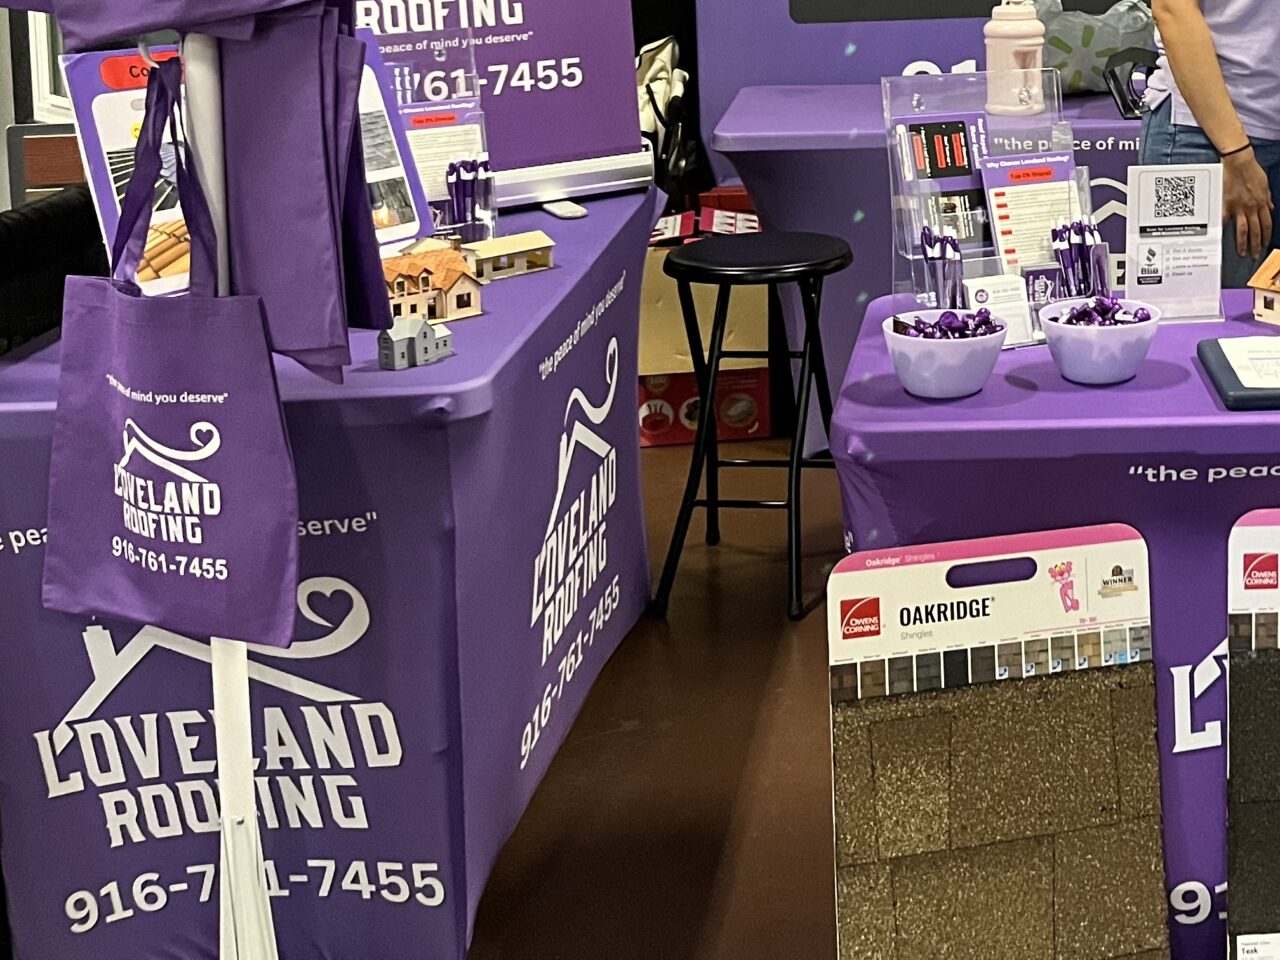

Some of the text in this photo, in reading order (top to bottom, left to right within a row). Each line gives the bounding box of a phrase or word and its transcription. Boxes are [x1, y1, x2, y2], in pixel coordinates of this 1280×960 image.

[415, 37, 427, 51] of
[430, 36, 460, 51] mind
[1096, 136, 1116, 152] of
[155, 395, 177, 406] you
[122, 500, 203, 544] ROOFING
[531, 445, 617, 629] LOVELAND
[111, 535, 229, 580] 916-761-7455
[1102, 575, 1134, 587] WINNER
[1246, 577, 1278, 586] CORNING
[1251, 570, 1277, 579] OWENS
[541, 520, 608, 668] ROOFING
[849, 616, 879, 626] OWENS
[844, 623, 880, 635] CORNING
[900, 629, 933, 641] Shingles
[519, 573, 621, 771] 916-761-7455
[32, 700, 403, 800] LOVEAND
[98, 773, 369, 849] ROOING
